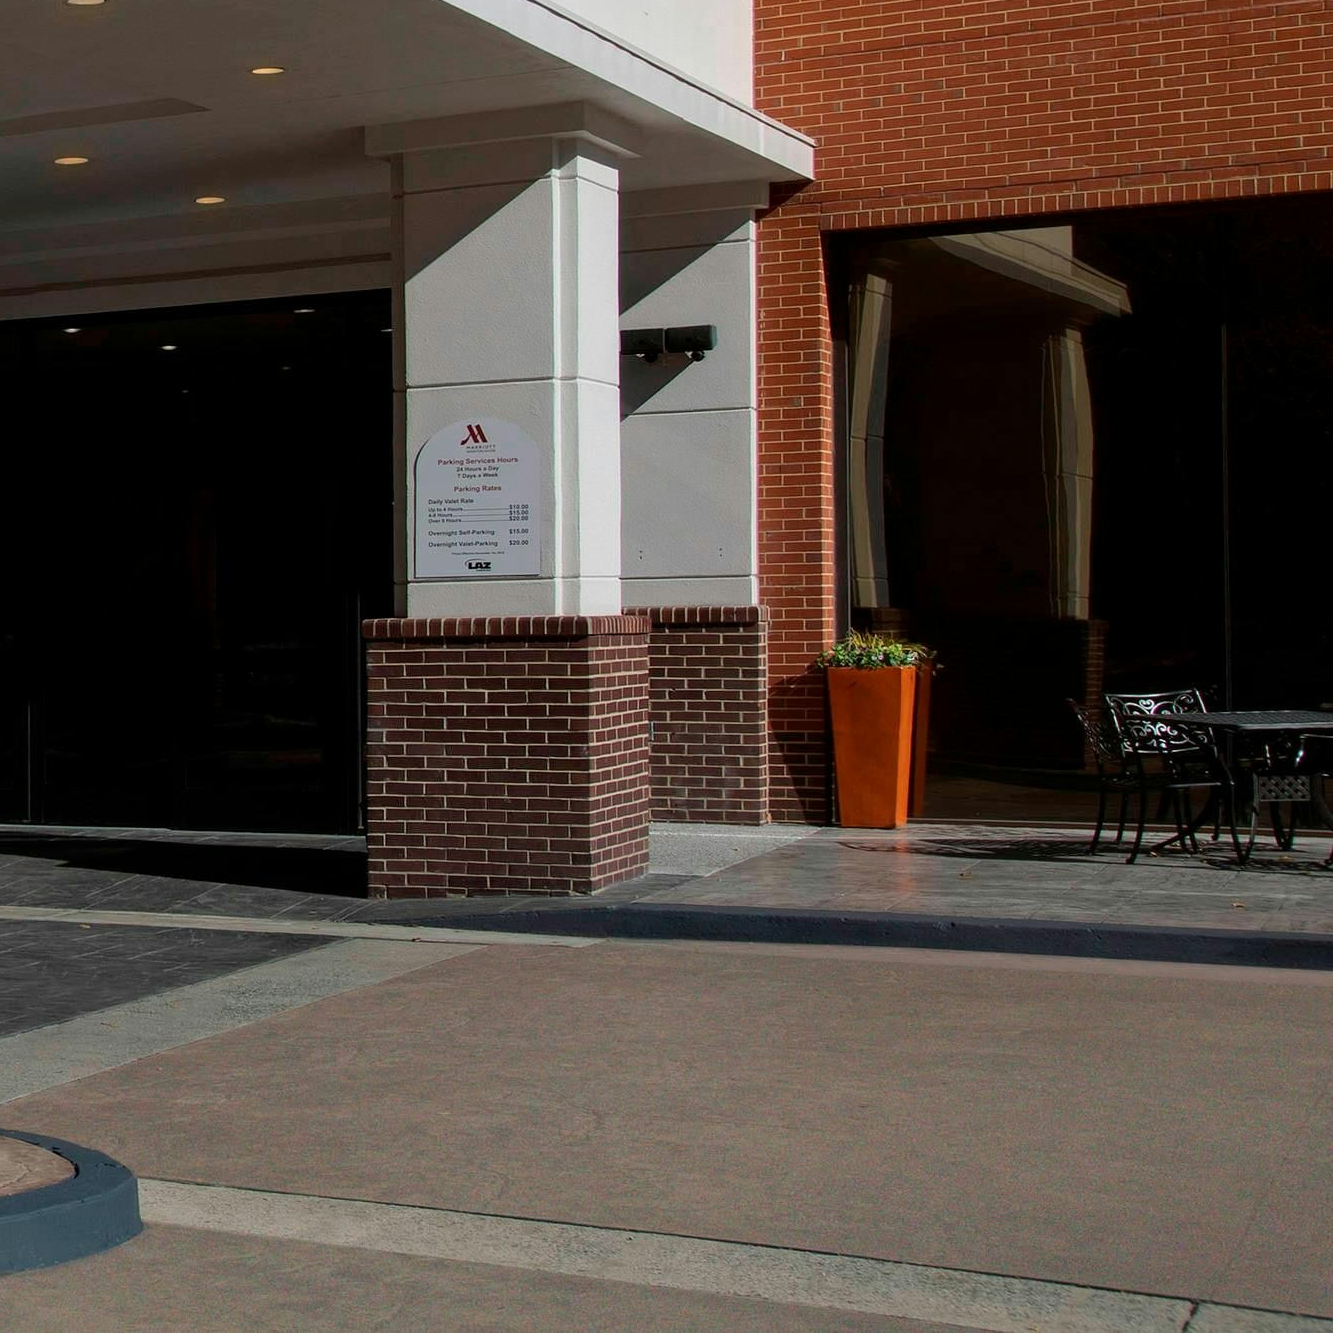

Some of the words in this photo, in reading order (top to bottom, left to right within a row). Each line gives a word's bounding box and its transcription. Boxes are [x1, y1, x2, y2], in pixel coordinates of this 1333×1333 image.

[437, 458, 464, 466] Parking
[465, 457, 495, 465] Services
[428, 529, 457, 537] Overnight
[468, 562, 492, 570] LAZ
